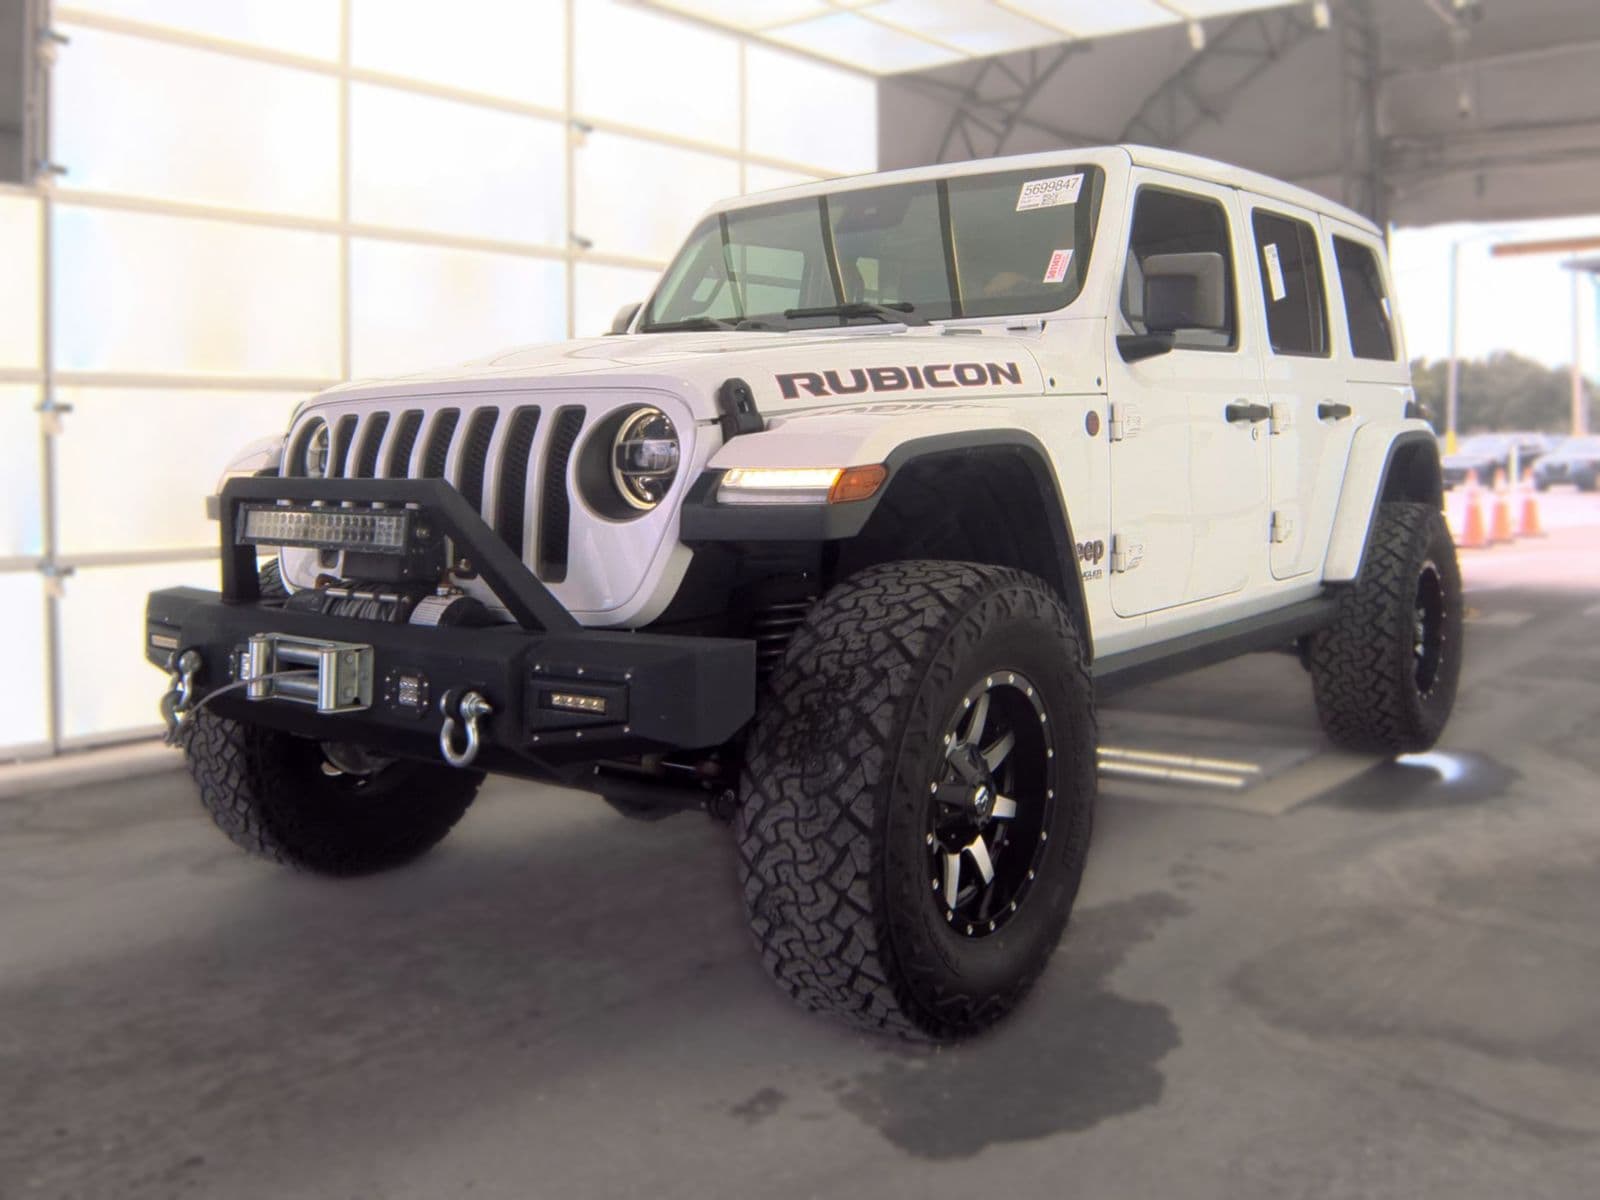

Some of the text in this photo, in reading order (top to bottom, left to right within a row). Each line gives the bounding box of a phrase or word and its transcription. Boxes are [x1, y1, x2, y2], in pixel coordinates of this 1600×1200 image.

[1024, 177, 1080, 195] 5699847
[775, 361, 1023, 400] RUBICON
[1077, 540, 1104, 565] eep
